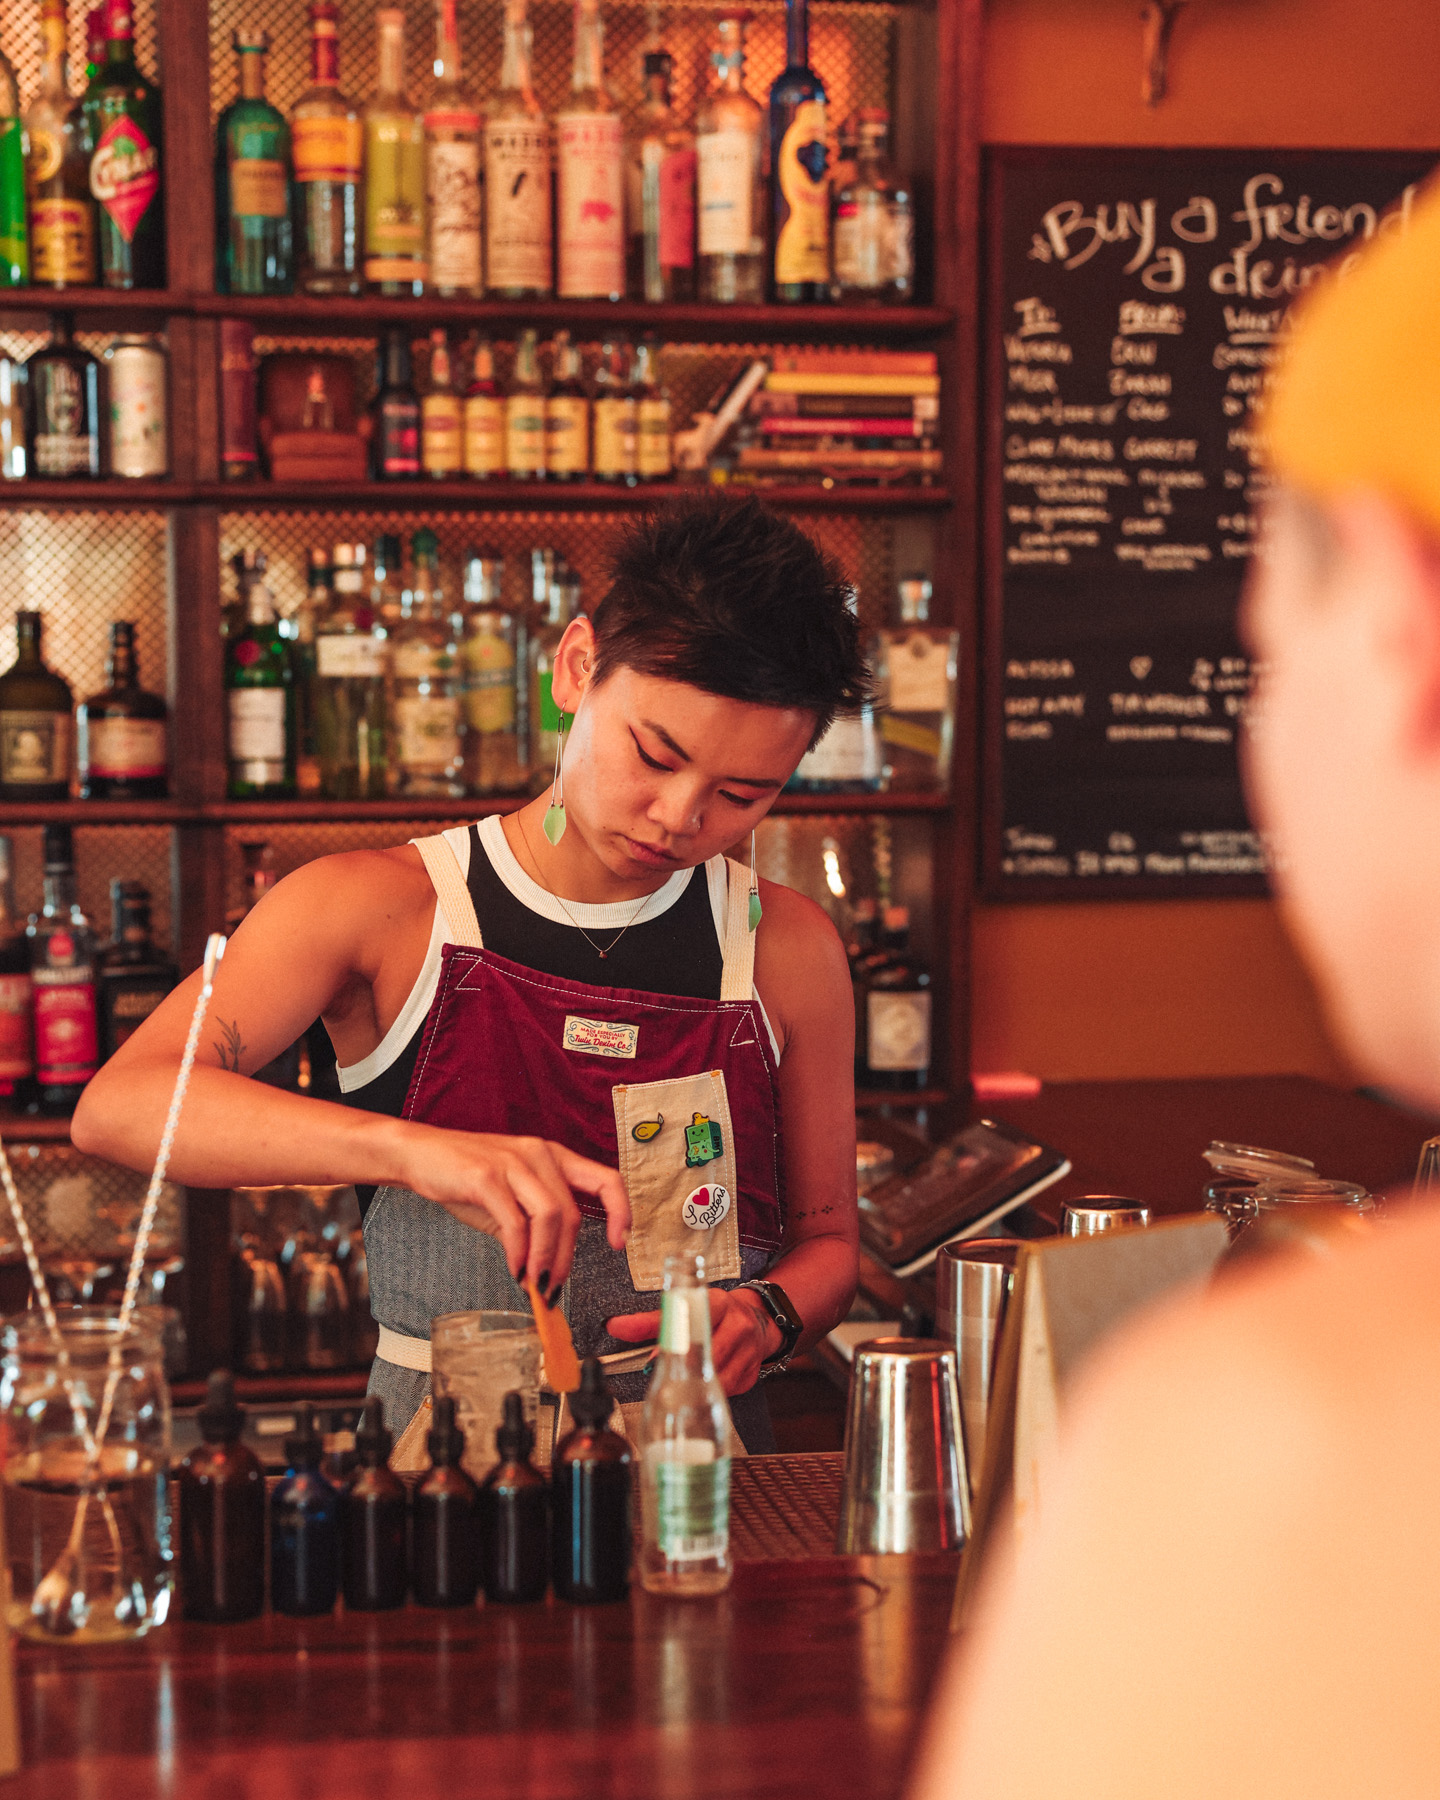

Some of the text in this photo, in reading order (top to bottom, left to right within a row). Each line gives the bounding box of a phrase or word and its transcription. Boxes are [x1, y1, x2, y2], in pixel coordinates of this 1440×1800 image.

[1041, 172, 1418, 275] Buy a friend
[1141, 246, 1361, 300] a drin
[575, 1034, 591, 1043] Twin
[593, 1038, 616, 1047] Denim
[598, 1030, 625, 1038] ESPECIALLY
[699, 1187, 726, 1229] Bitters
